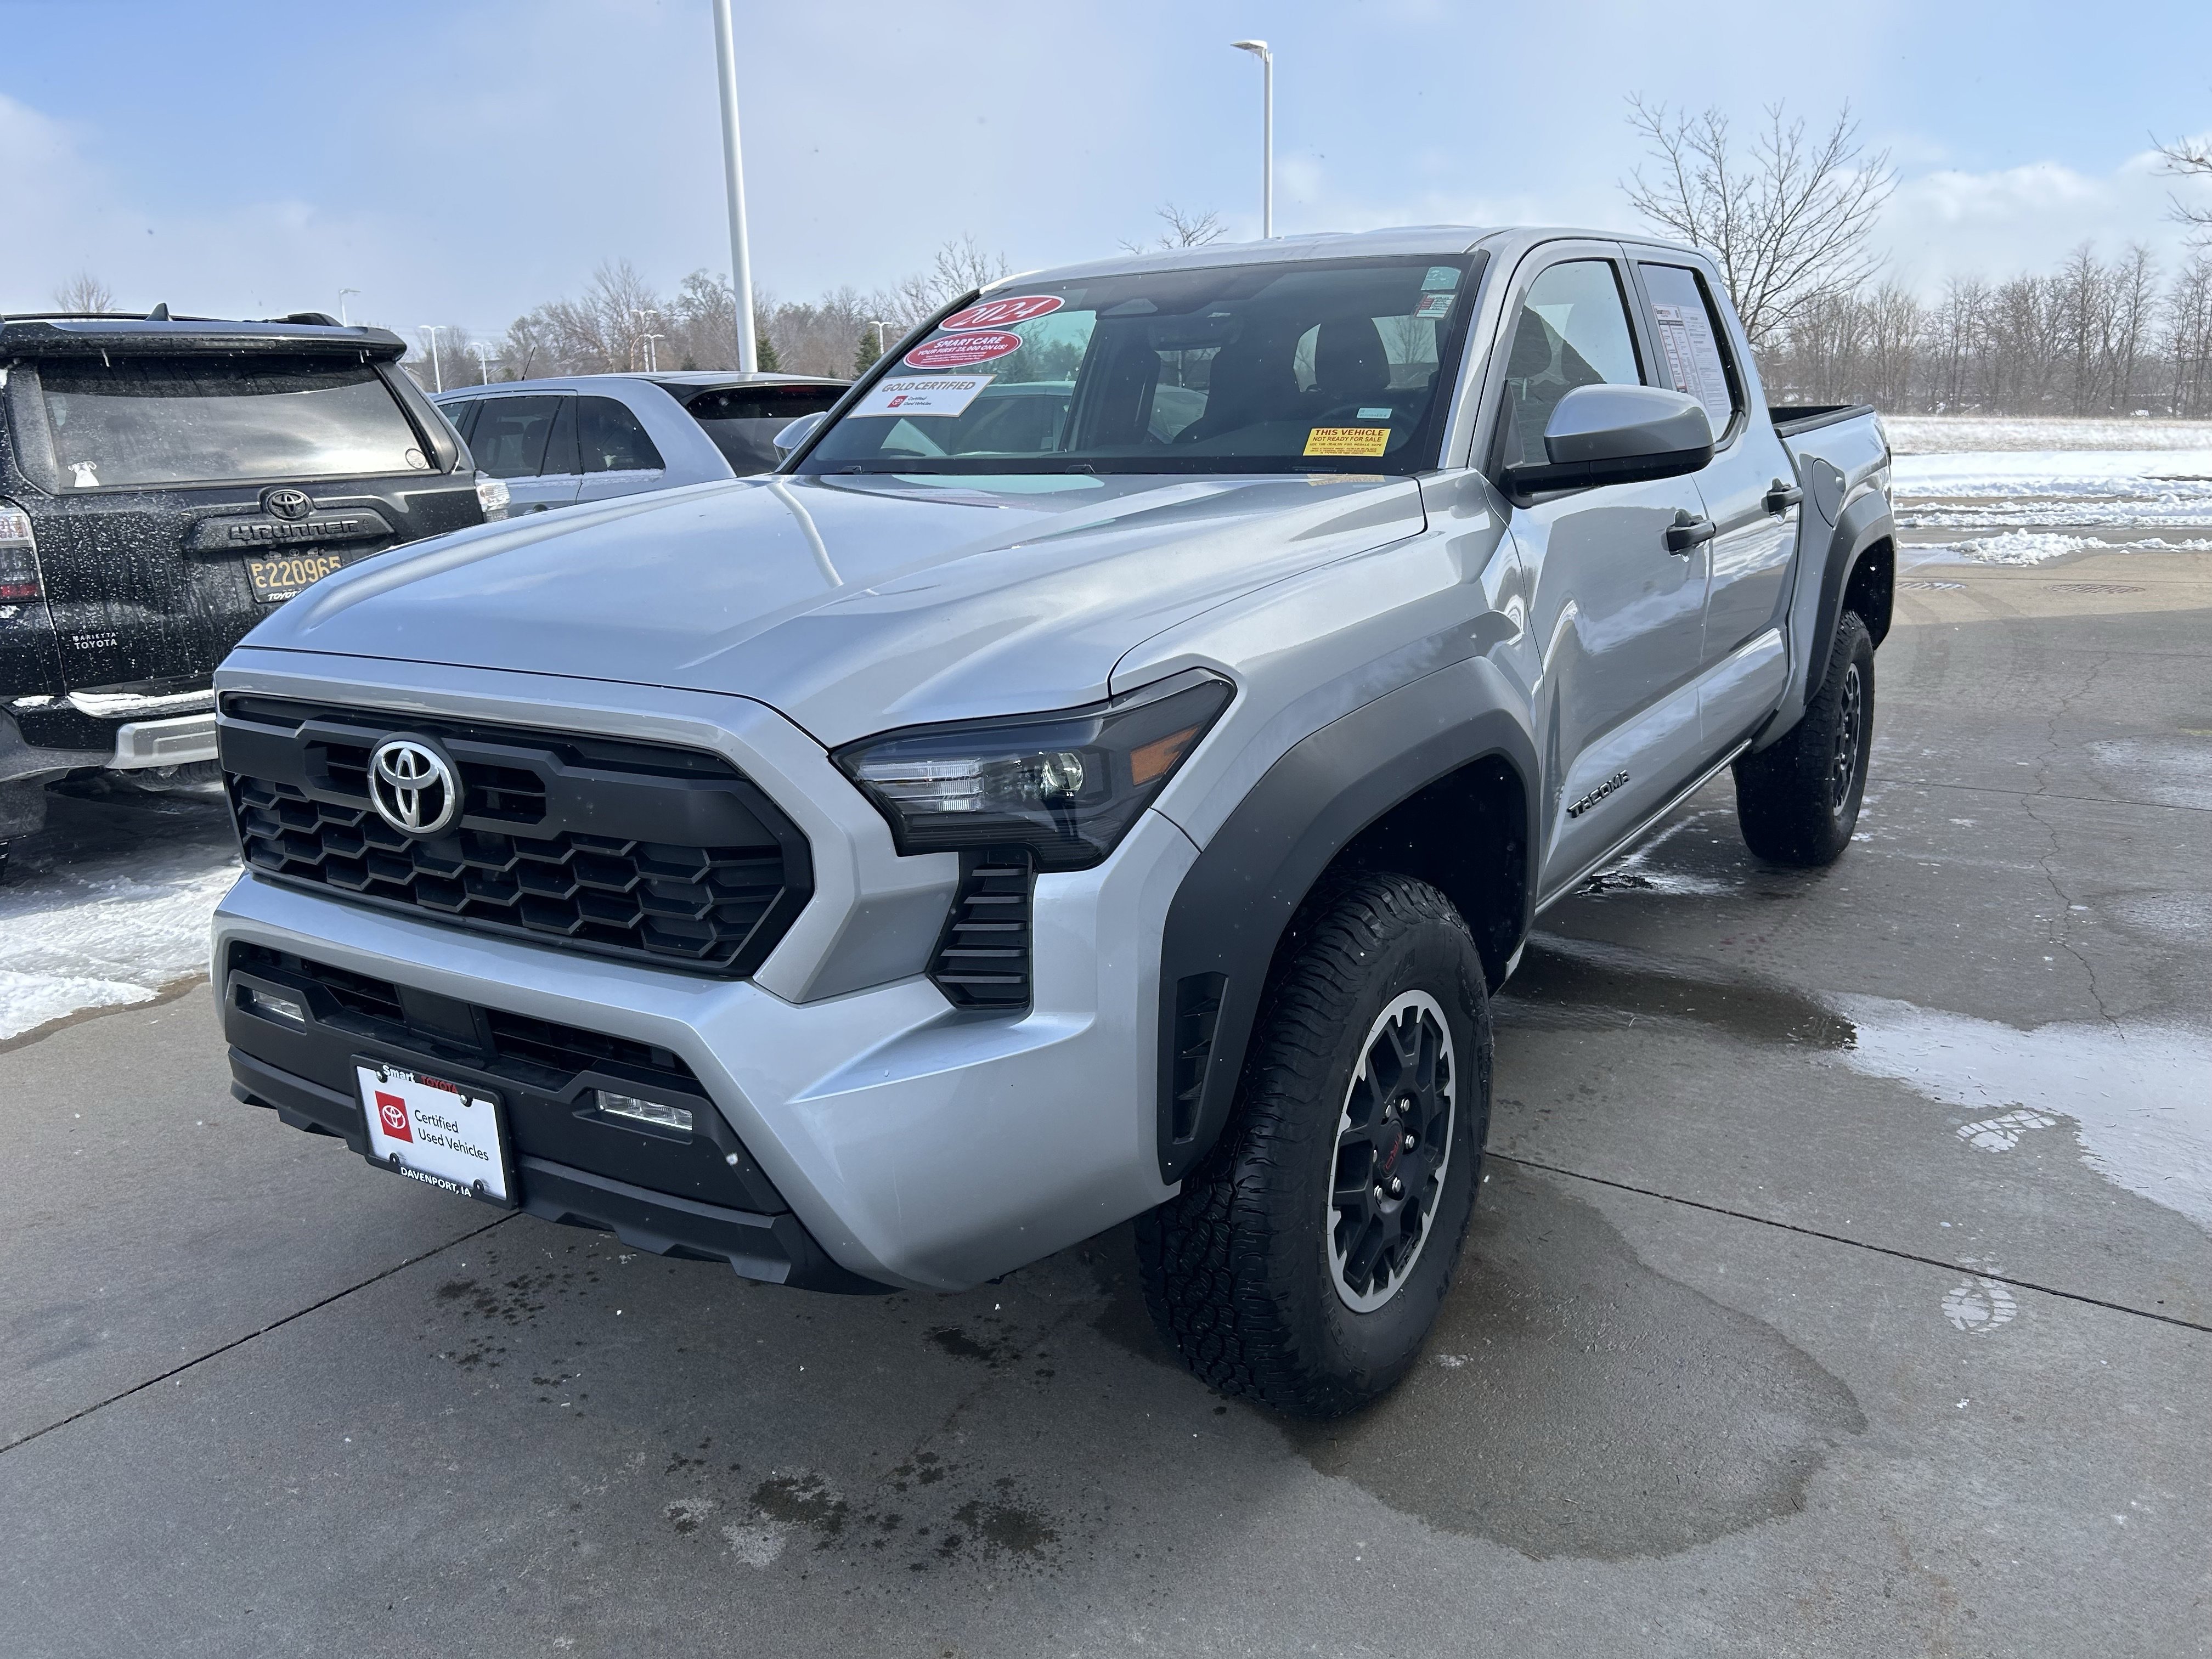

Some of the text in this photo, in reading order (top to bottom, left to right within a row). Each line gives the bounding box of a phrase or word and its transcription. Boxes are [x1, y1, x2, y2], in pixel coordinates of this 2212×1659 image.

[950, 298, 1052, 328] 2024
[934, 336, 1005, 348] SMART CARE
[882, 381, 976, 392] GOLD CERTIFIED
[266, 556, 342, 587] 220965
[268, 590, 302, 601] TOYOT
[72, 632, 116, 642] MARIETTA
[74, 639, 117, 650] TOYOTA
[1567, 770, 1630, 818] TACOMA
[382, 1065, 459, 1094] Smart TOYOTA
[414, 1109, 459, 1134] Certified
[417, 1128, 489, 1161] Used Vehicles
[400, 1167, 472, 1198] DAVENPORT, IA
